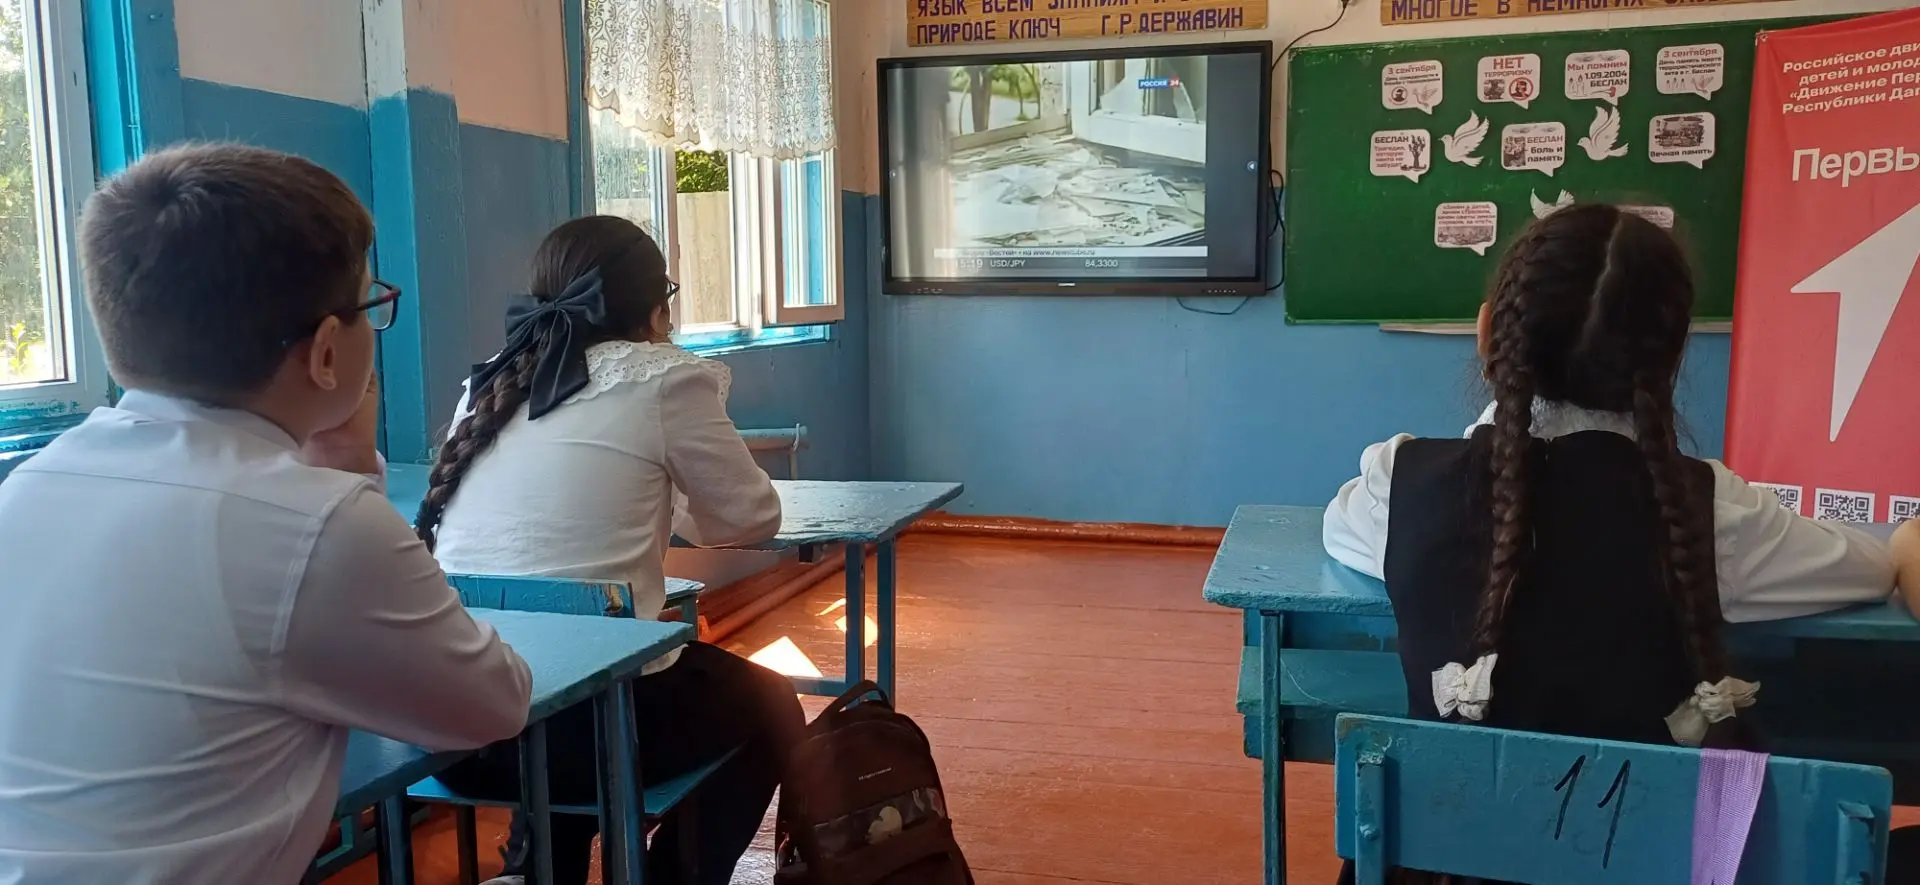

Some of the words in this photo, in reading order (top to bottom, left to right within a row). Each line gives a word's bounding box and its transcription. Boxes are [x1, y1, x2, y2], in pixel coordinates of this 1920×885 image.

[917, 0, 967, 17] ЯЗЫК
[1497, 0, 1511, 14] В
[916, 20, 996, 44] ПРИРОДЕ
[1008, 17, 1061, 39] КЛЮЧ
[1671, 48, 1717, 57] сентября
[1493, 56, 1524, 70] НЕТ
[1567, 63, 1584, 71] Мы
[1587, 61, 1627, 70] помним
[1783, 48, 1887, 73] Российское
[1396, 64, 1437, 74] сентября
[1484, 69, 1533, 77] ТЕРРОРИЗМУ
[1799, 67, 1849, 86] детей
[1852, 66, 1863, 76] и
[1590, 79, 1627, 87] БЕСЛАН
[1790, 77, 1887, 100] «Движение
[1782, 94, 1886, 114] Республики
[1527, 135, 1563, 143] БЕСЛАН
[990, 259, 1026, 268] USD/JPY
